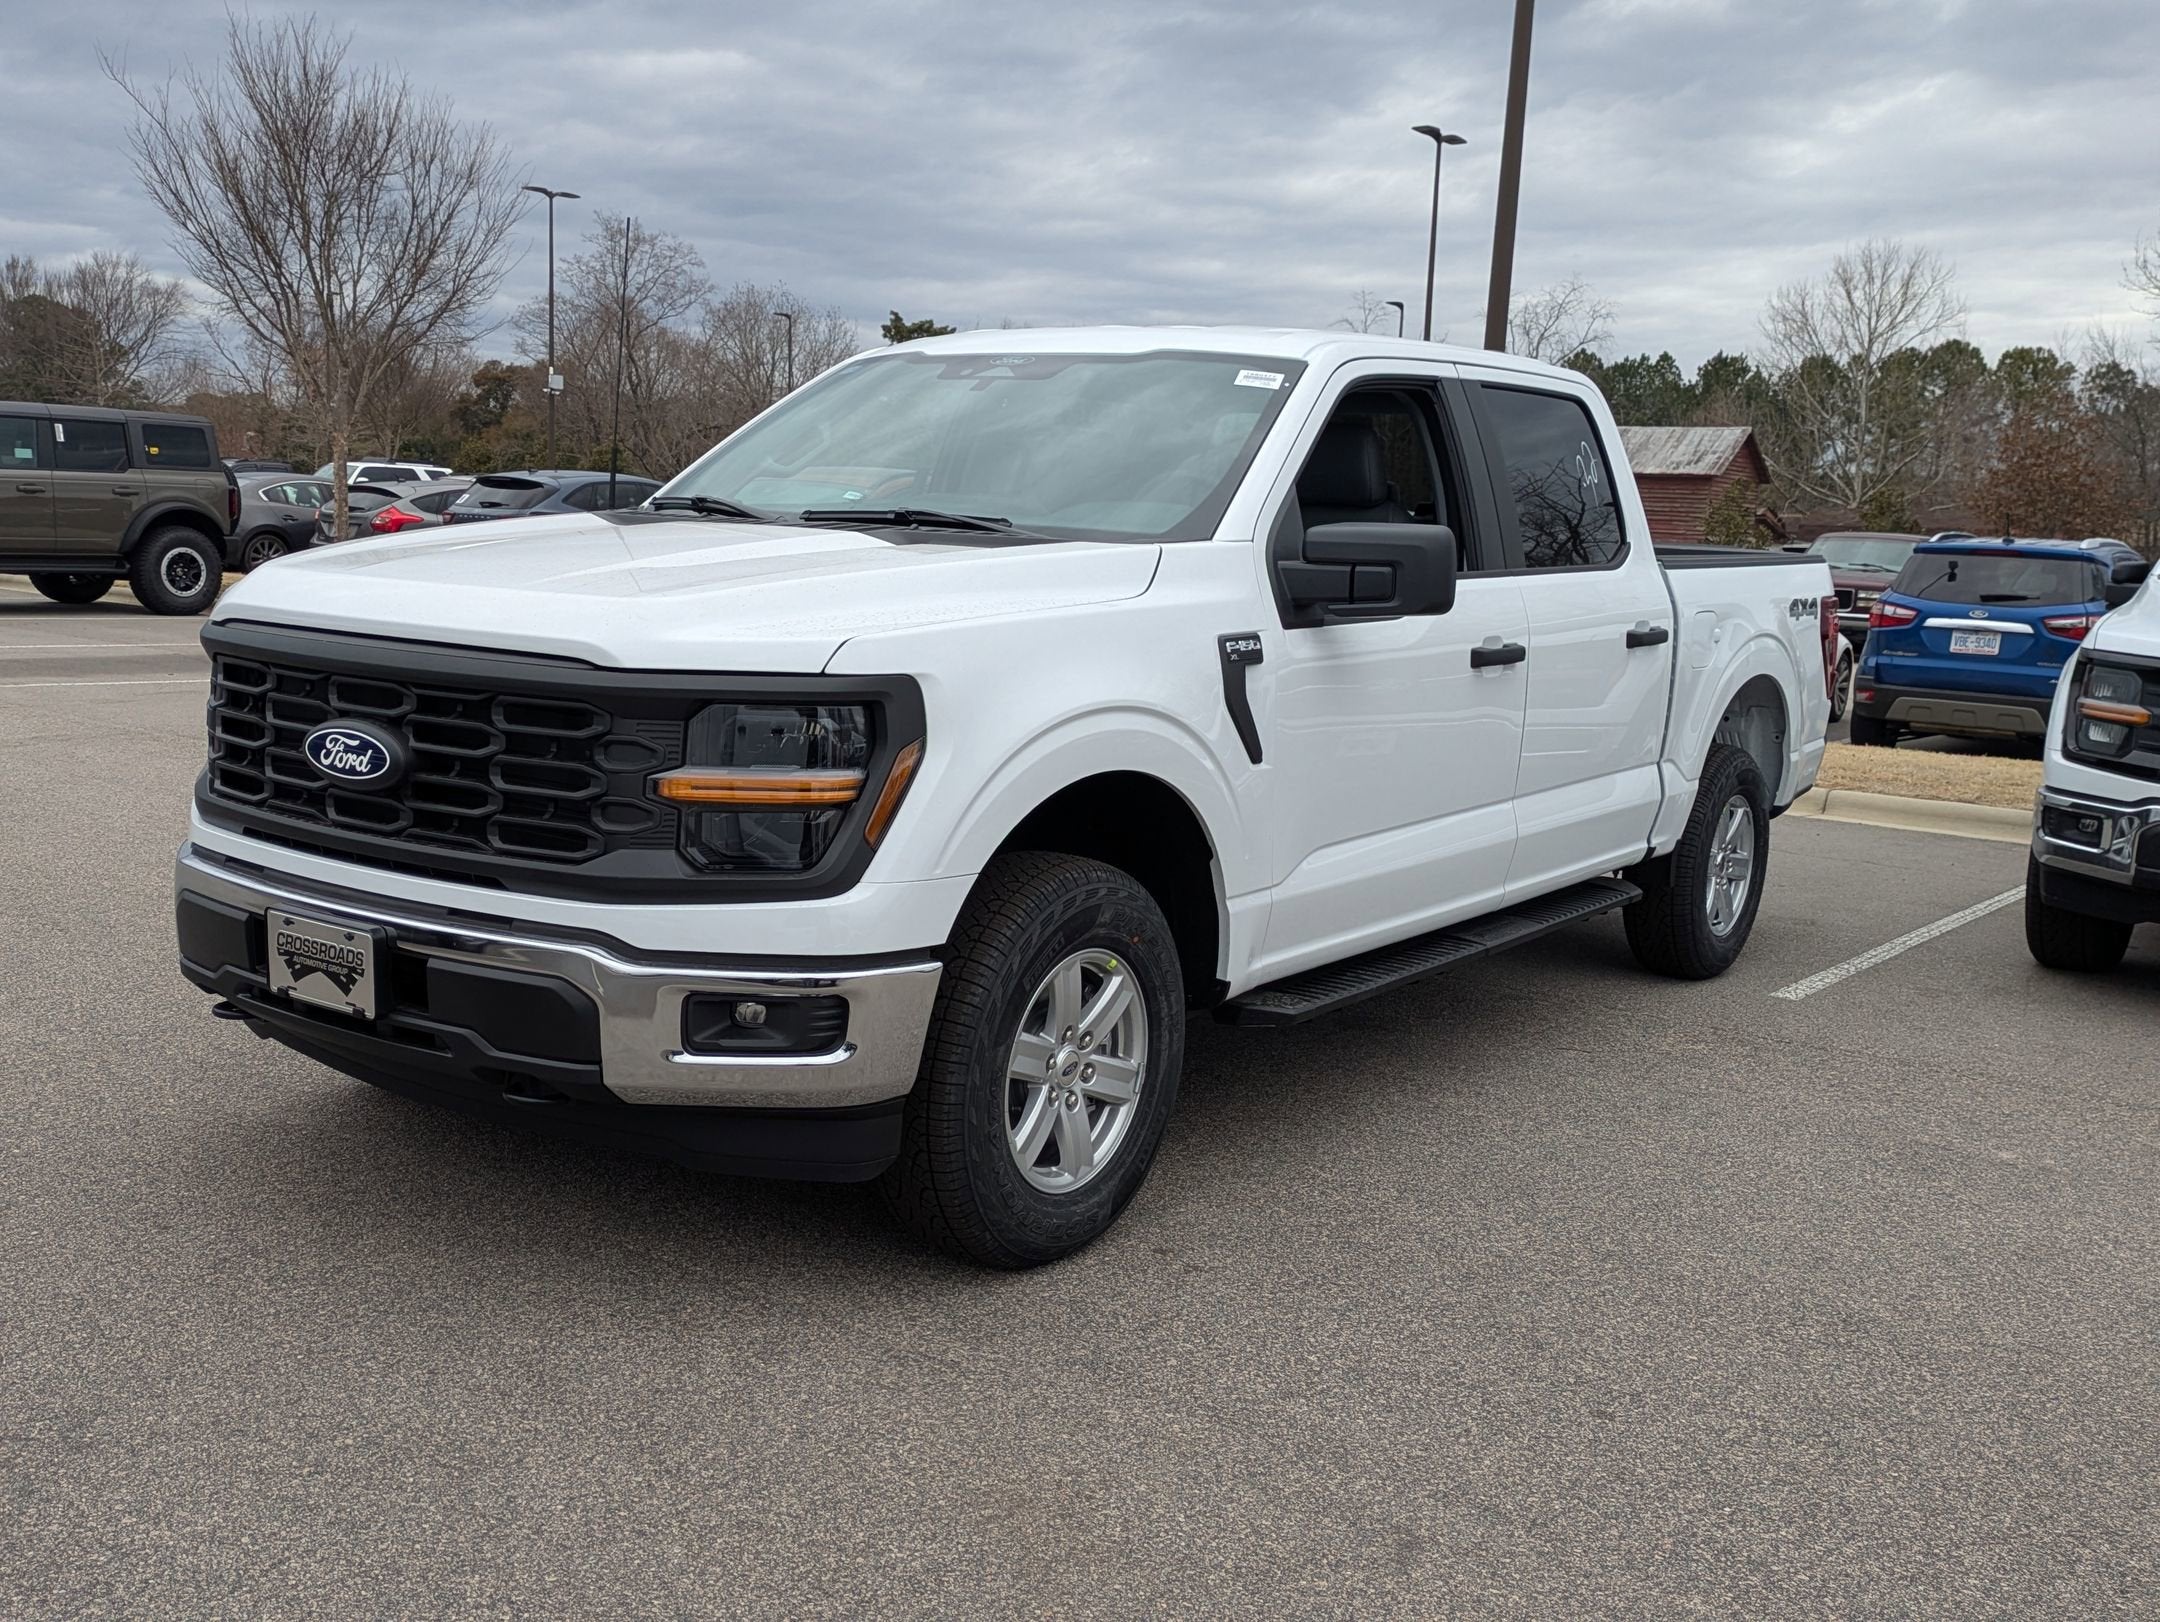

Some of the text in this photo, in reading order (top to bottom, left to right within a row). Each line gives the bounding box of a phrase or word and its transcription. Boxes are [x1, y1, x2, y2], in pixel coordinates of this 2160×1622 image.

[1226, 639, 1261, 653] F-150
[320, 734, 373, 773] Ford
[276, 932, 365, 968] CROSSROADS
[292, 955, 349, 975] AUTOMOTIVE GROUP
